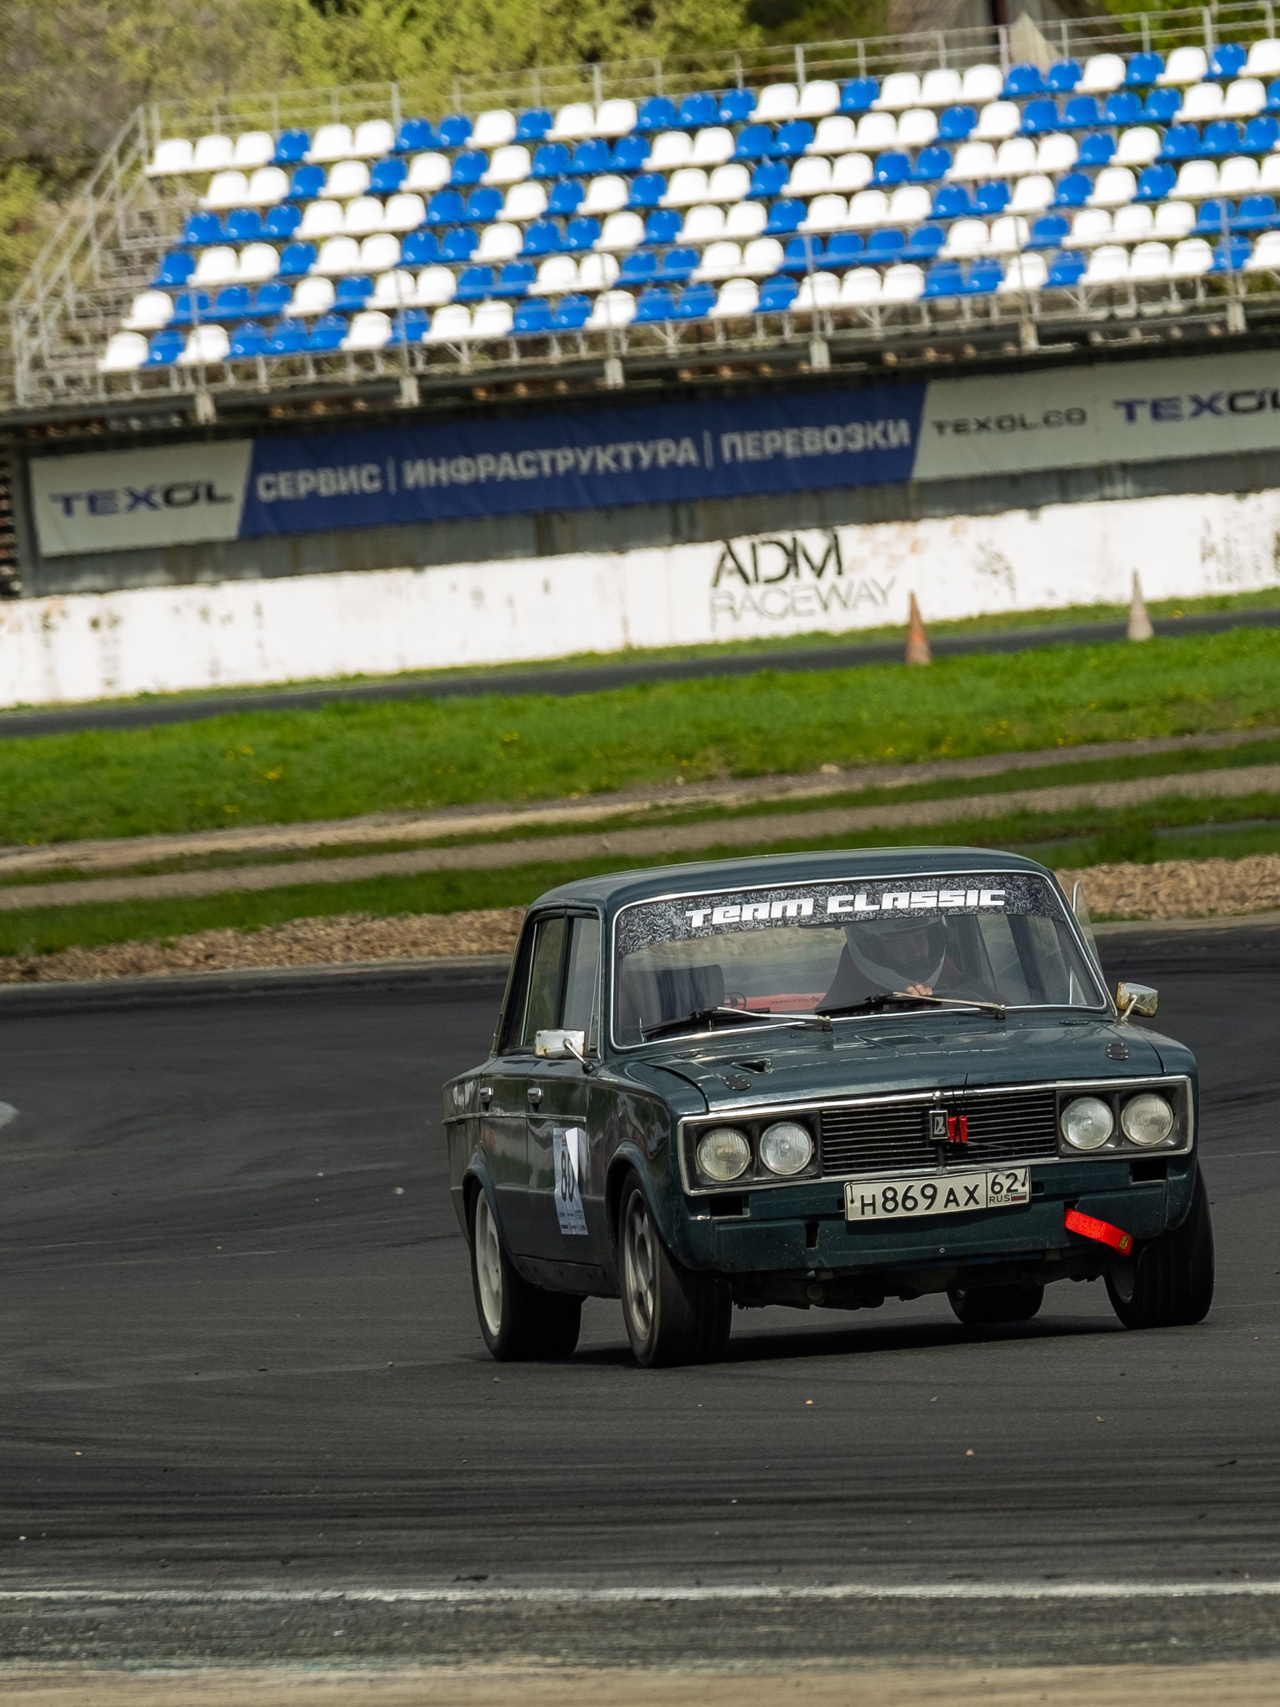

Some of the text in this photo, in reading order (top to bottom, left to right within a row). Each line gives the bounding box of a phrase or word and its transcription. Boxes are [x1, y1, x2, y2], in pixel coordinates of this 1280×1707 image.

[256, 418, 911, 503] СЕРВИС ИНФРАСТРУКТУРА ПЕРЕВОЗКИ
[49, 479, 235, 519] TEXOL
[713, 532, 843, 588] ADM
[711, 575, 896, 632] RACEWAY
[989, 1194, 1011, 1204] RUS
[990, 1172, 1019, 1195] 62
